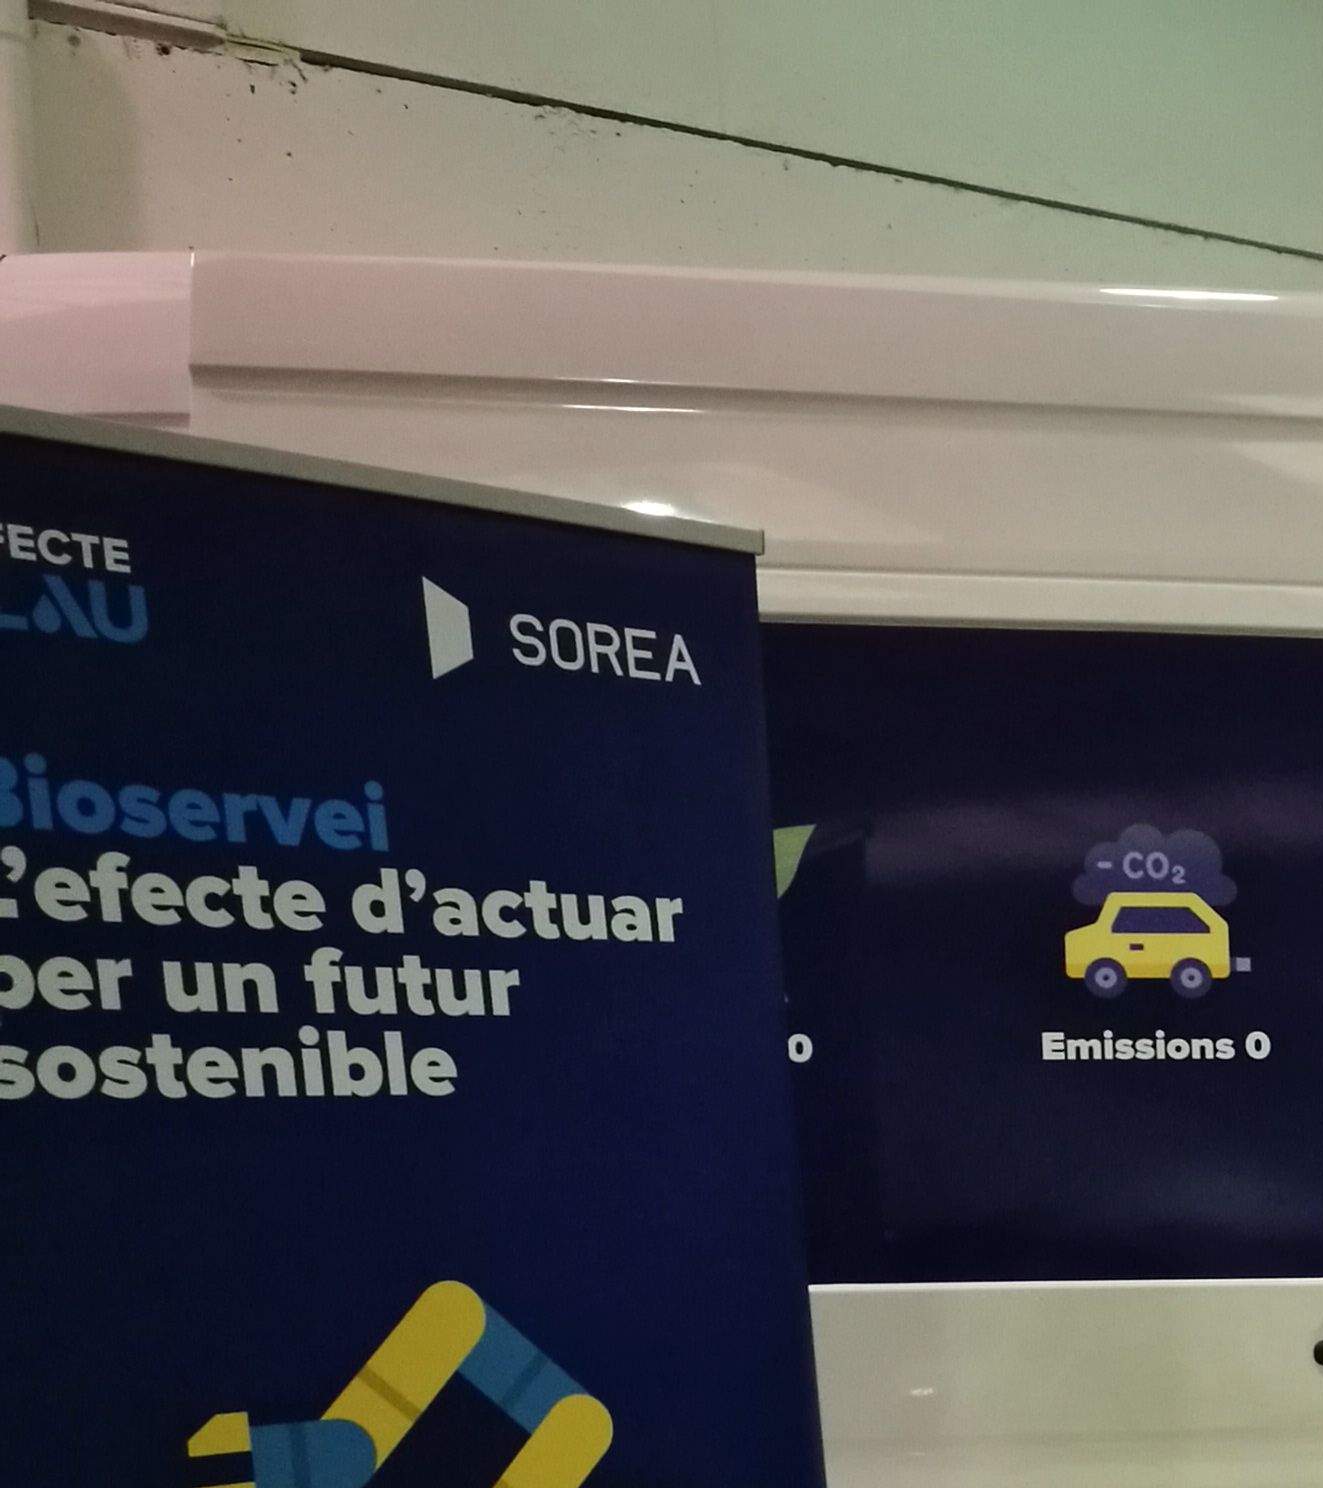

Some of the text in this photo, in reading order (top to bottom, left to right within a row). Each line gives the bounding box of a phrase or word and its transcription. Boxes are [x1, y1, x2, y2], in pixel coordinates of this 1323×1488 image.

[509, 614, 702, 685] SOREA
[352, 868, 684, 942] d'actuar
[162, 961, 279, 1013] un
[303, 946, 521, 1017] futur
[0, 1024, 458, 1099] sostenible
[1041, 1029, 1271, 1061] Emissions 0
